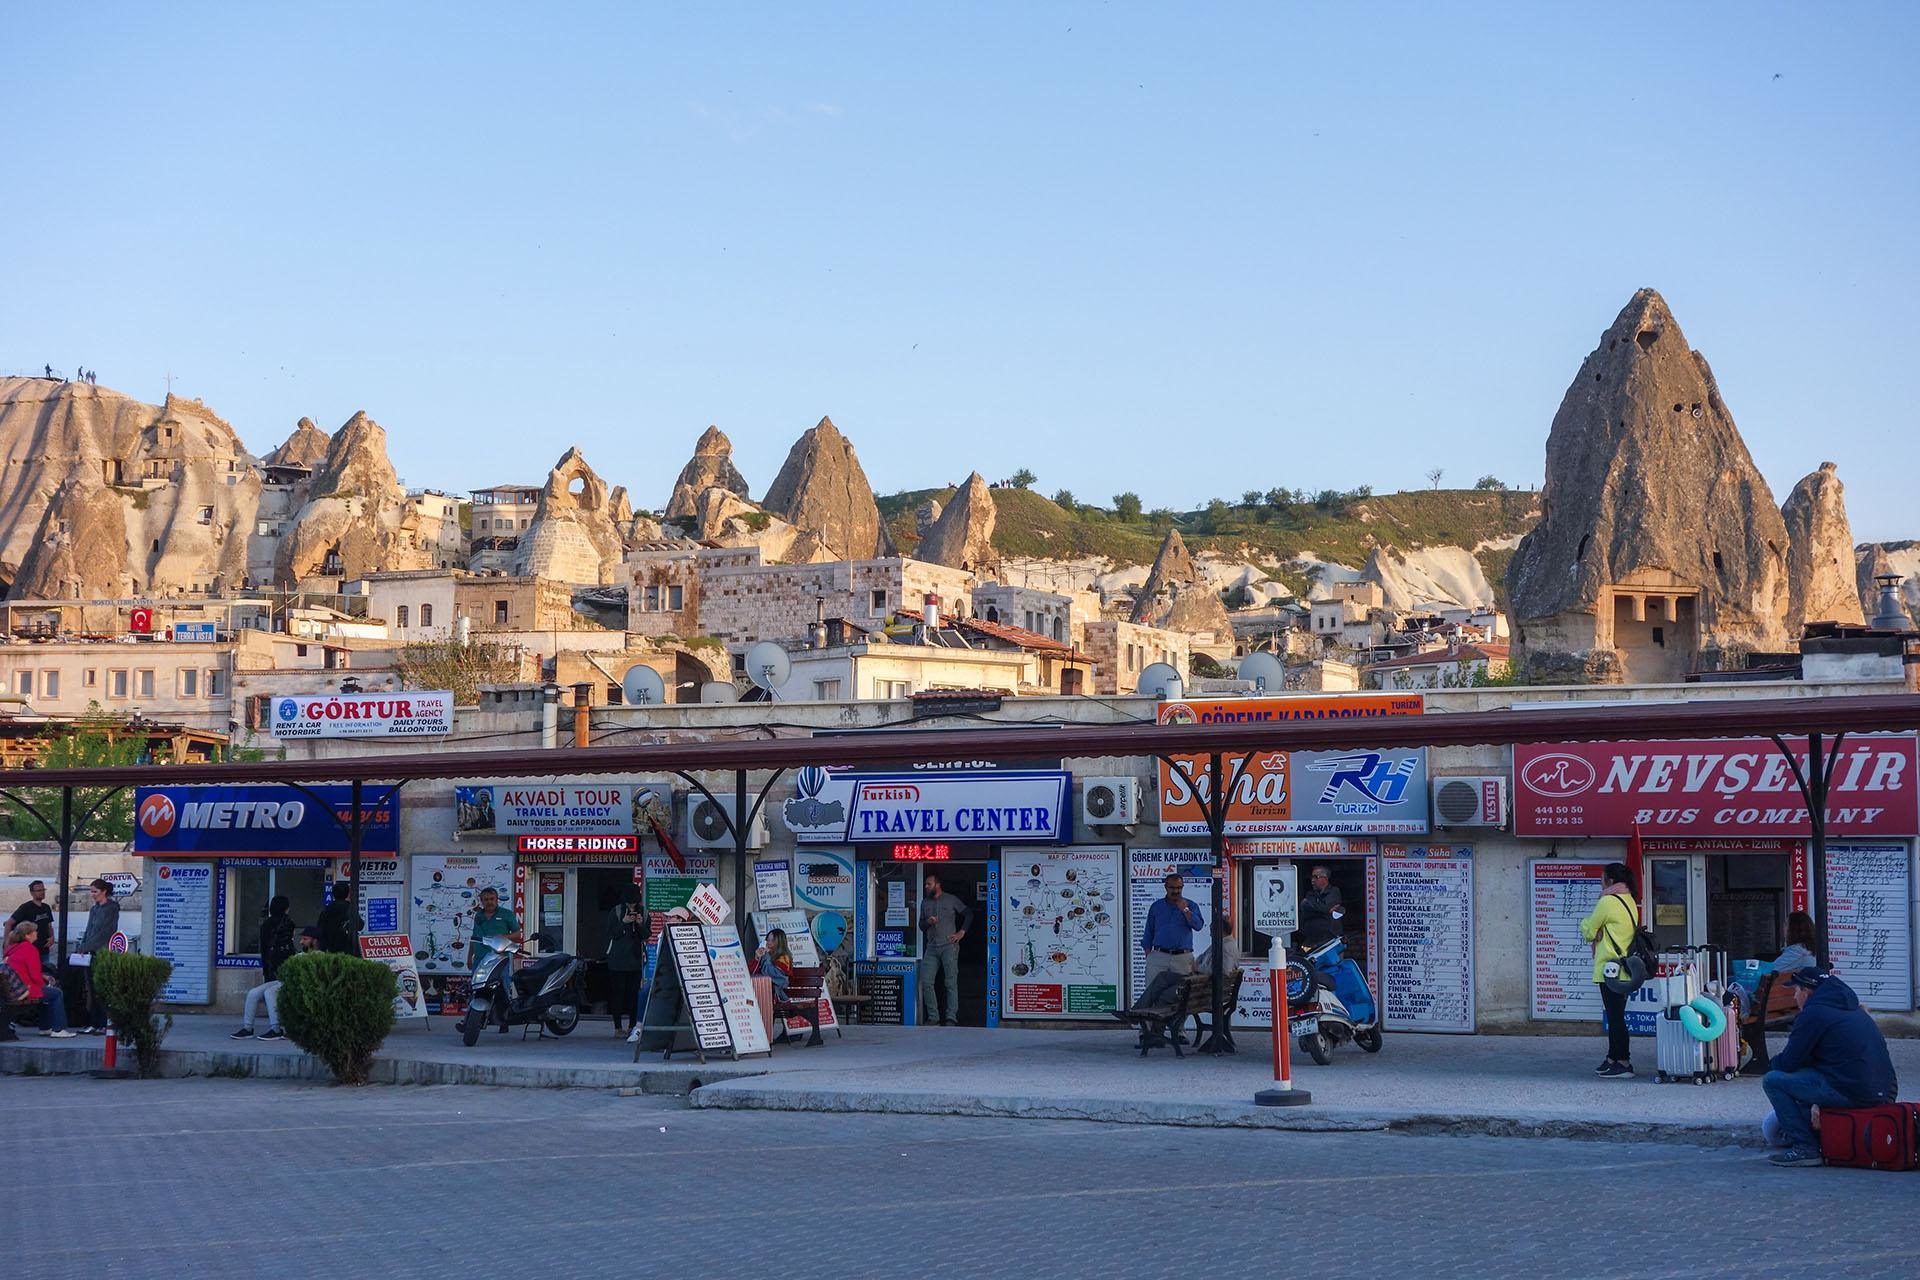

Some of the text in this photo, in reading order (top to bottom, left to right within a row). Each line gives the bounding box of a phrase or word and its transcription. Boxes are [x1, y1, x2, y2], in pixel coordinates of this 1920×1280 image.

[306, 698, 412, 720] GÖRTUR
[504, 787, 621, 806] AKVADİ TOUR
[862, 789, 911, 801] Turkish
[1487, 782, 1496, 821] VESTEL
[180, 801, 305, 829] METRO
[515, 808, 611, 817] TRAVEL AGENCY
[1634, 808, 1699, 824] BUS
[860, 807, 1051, 832] TRAVEL CENTER
[1248, 823, 1287, 832] ELBİSTAN
[1335, 822, 1362, 832] BİRLİK
[527, 839, 626, 849] HORSE RIDING
[1231, 842, 1259, 854] DIRECT
[1260, 838, 1296, 854] FETHİYE
[1304, 842, 1343, 853] ANTALYA
[1642, 840, 1687, 849] FETHİYE
[1696, 840, 1742, 849] ANTALYA
[1384, 847, 1405, 856] Süha
[1428, 848, 1450, 857] Süha
[519, 854, 638, 863] BALLOON FLIGHT RESERVATION
[1132, 852, 1208, 862] GÖREME KAPADOKYA
[690, 859, 715, 868] TOUR
[172, 869, 209, 878] METRO
[1132, 864, 1160, 877] Süha
[806, 886, 835, 896] POINT
[692, 896, 703, 908] ATV
[703, 892, 715, 909] RENT
[368, 936, 401, 946] CHANGE
[365, 947, 409, 957] EXCHANGE
